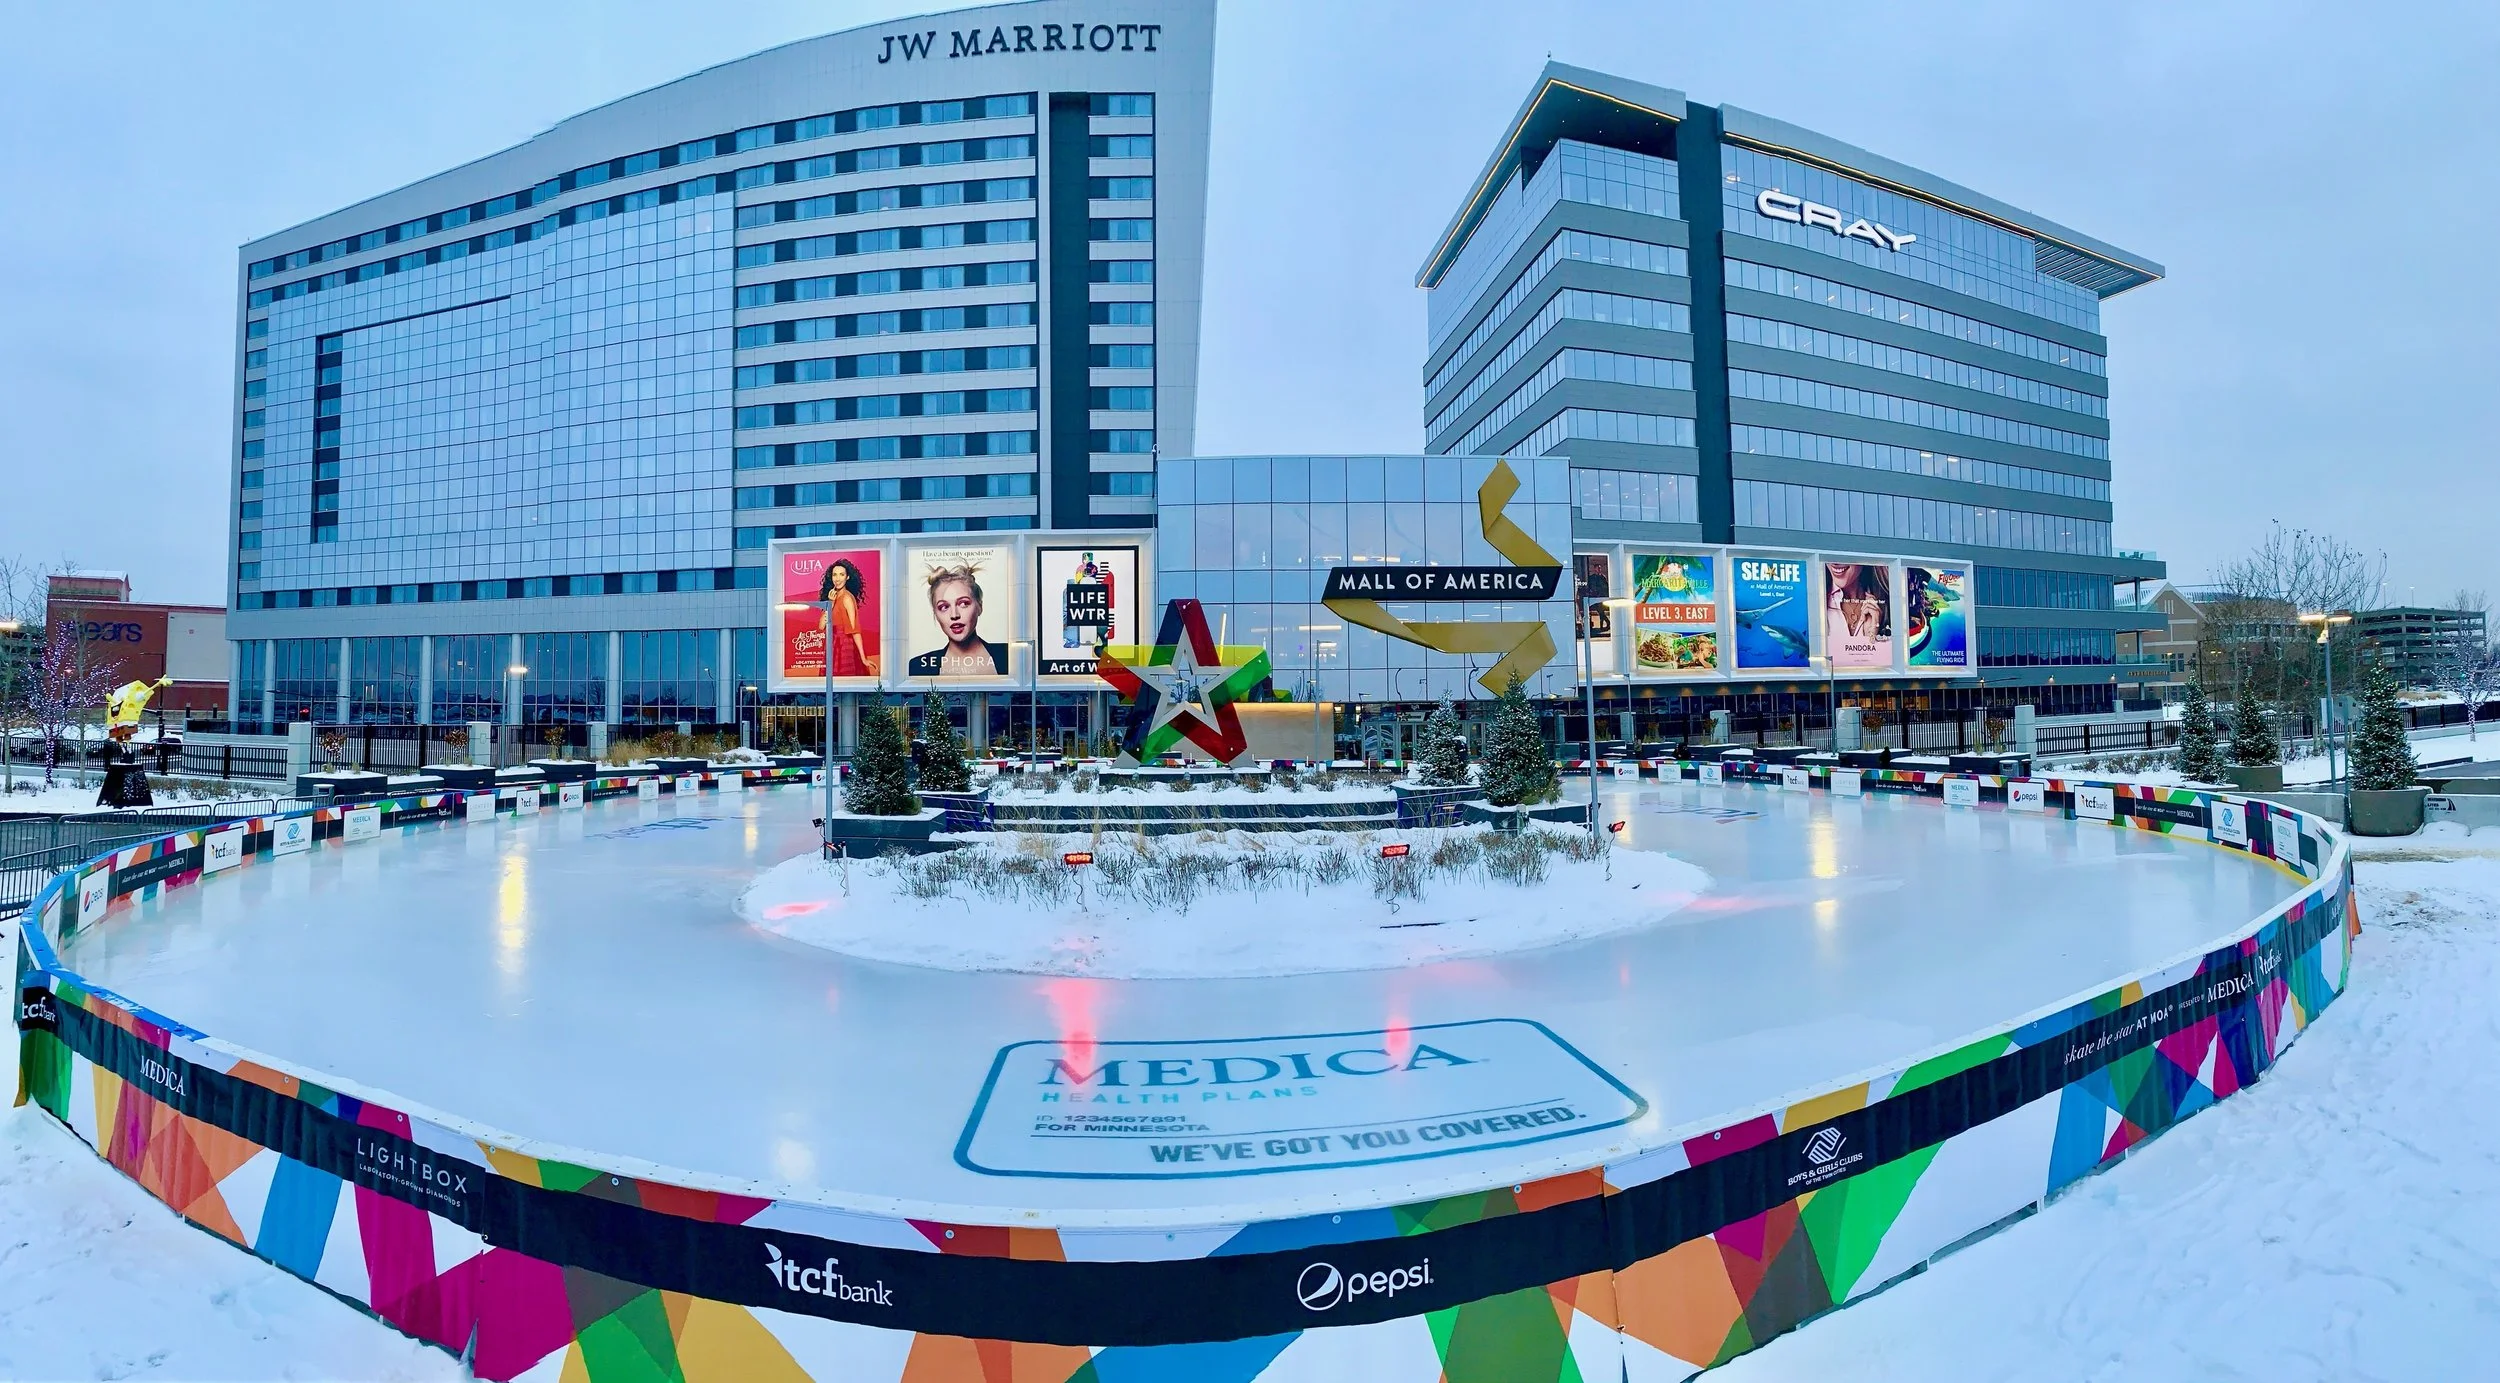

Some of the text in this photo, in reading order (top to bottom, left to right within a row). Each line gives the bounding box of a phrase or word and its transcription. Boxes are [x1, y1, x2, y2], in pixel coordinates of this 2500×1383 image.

[878, 23, 1161, 64] JW MARRIOTT
[1757, 189, 1917, 252] CRAY
[795, 559, 823, 571] ULTA
[1741, 561, 1770, 581] SEA
[1338, 573, 1544, 590] MALL OF AMERICA
[1070, 592, 1106, 604] LIFE
[1069, 608, 1106, 620] WTR
[1642, 607, 1709, 621] LEVEL 3, EAST
[1844, 644, 1877, 652] PANDORA
[920, 656, 995, 667] SEPHORA
[1049, 662, 1069, 673] Art
[1072, 662, 1085, 673] of
[2021, 793, 2038, 801] pepsi
[2176, 809, 2195, 819] MEDICA
[2064, 1041, 2095, 1066] skate
[2096, 1031, 2113, 1051] the
[2113, 1023, 2135, 1042] star
[2136, 1016, 2148, 1032] AT
[2207, 973, 2255, 1003] MEDICA
[1037, 1043, 1480, 1087] MEDICA
[139, 1055, 187, 1096] MEDICA
[1041, 1085, 1319, 1105] HEALTH PLANS
[1033, 1124, 1211, 1133] FOR MINNESOTA
[1150, 1105, 1587, 1163] WE'VE GOT YOU COVERED.
[357, 1137, 468, 1194] LIGHTBOX
[1787, 1152, 1864, 1186] BOYS & GIRLS CLUBS
[425, 1187, 462, 1208] DIAMONDS
[1347, 1257, 1431, 1303] pepsi
